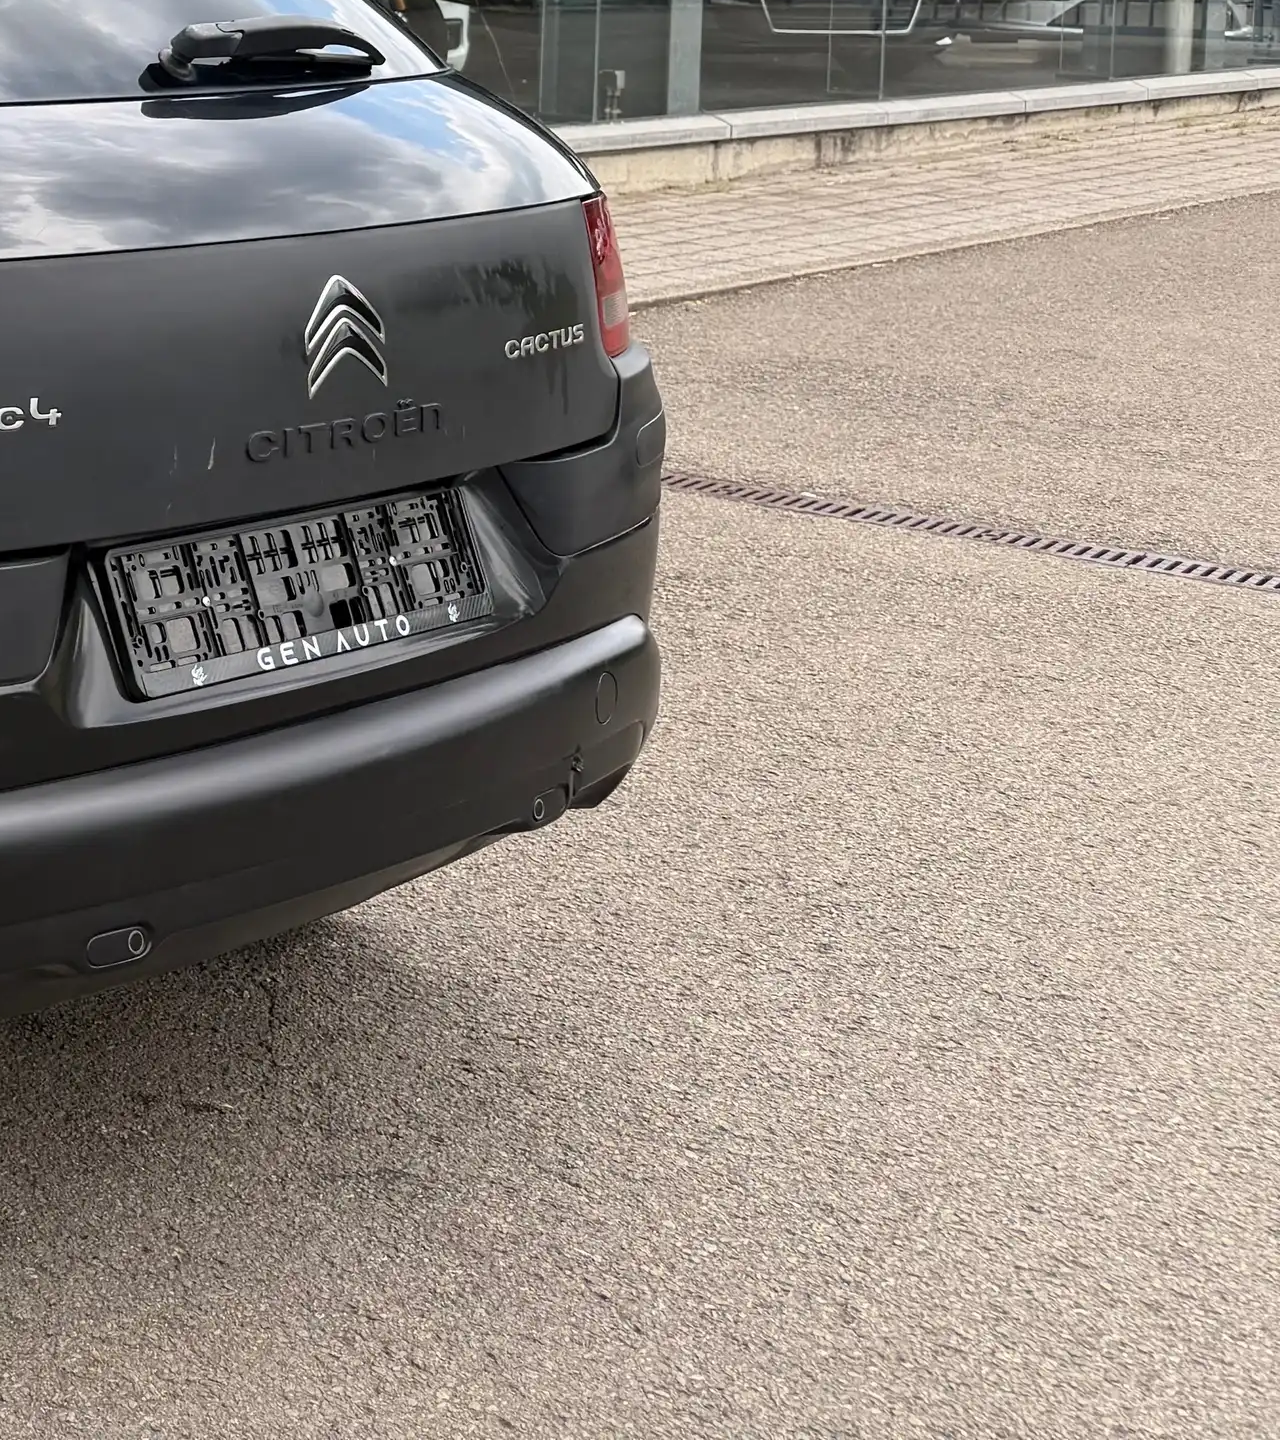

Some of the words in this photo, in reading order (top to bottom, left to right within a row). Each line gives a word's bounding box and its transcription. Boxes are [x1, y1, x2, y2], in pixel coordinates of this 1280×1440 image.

[503, 323, 585, 360] CACTUS
[256, 636, 323, 671] GEN
[336, 613, 411, 654] AUTO
